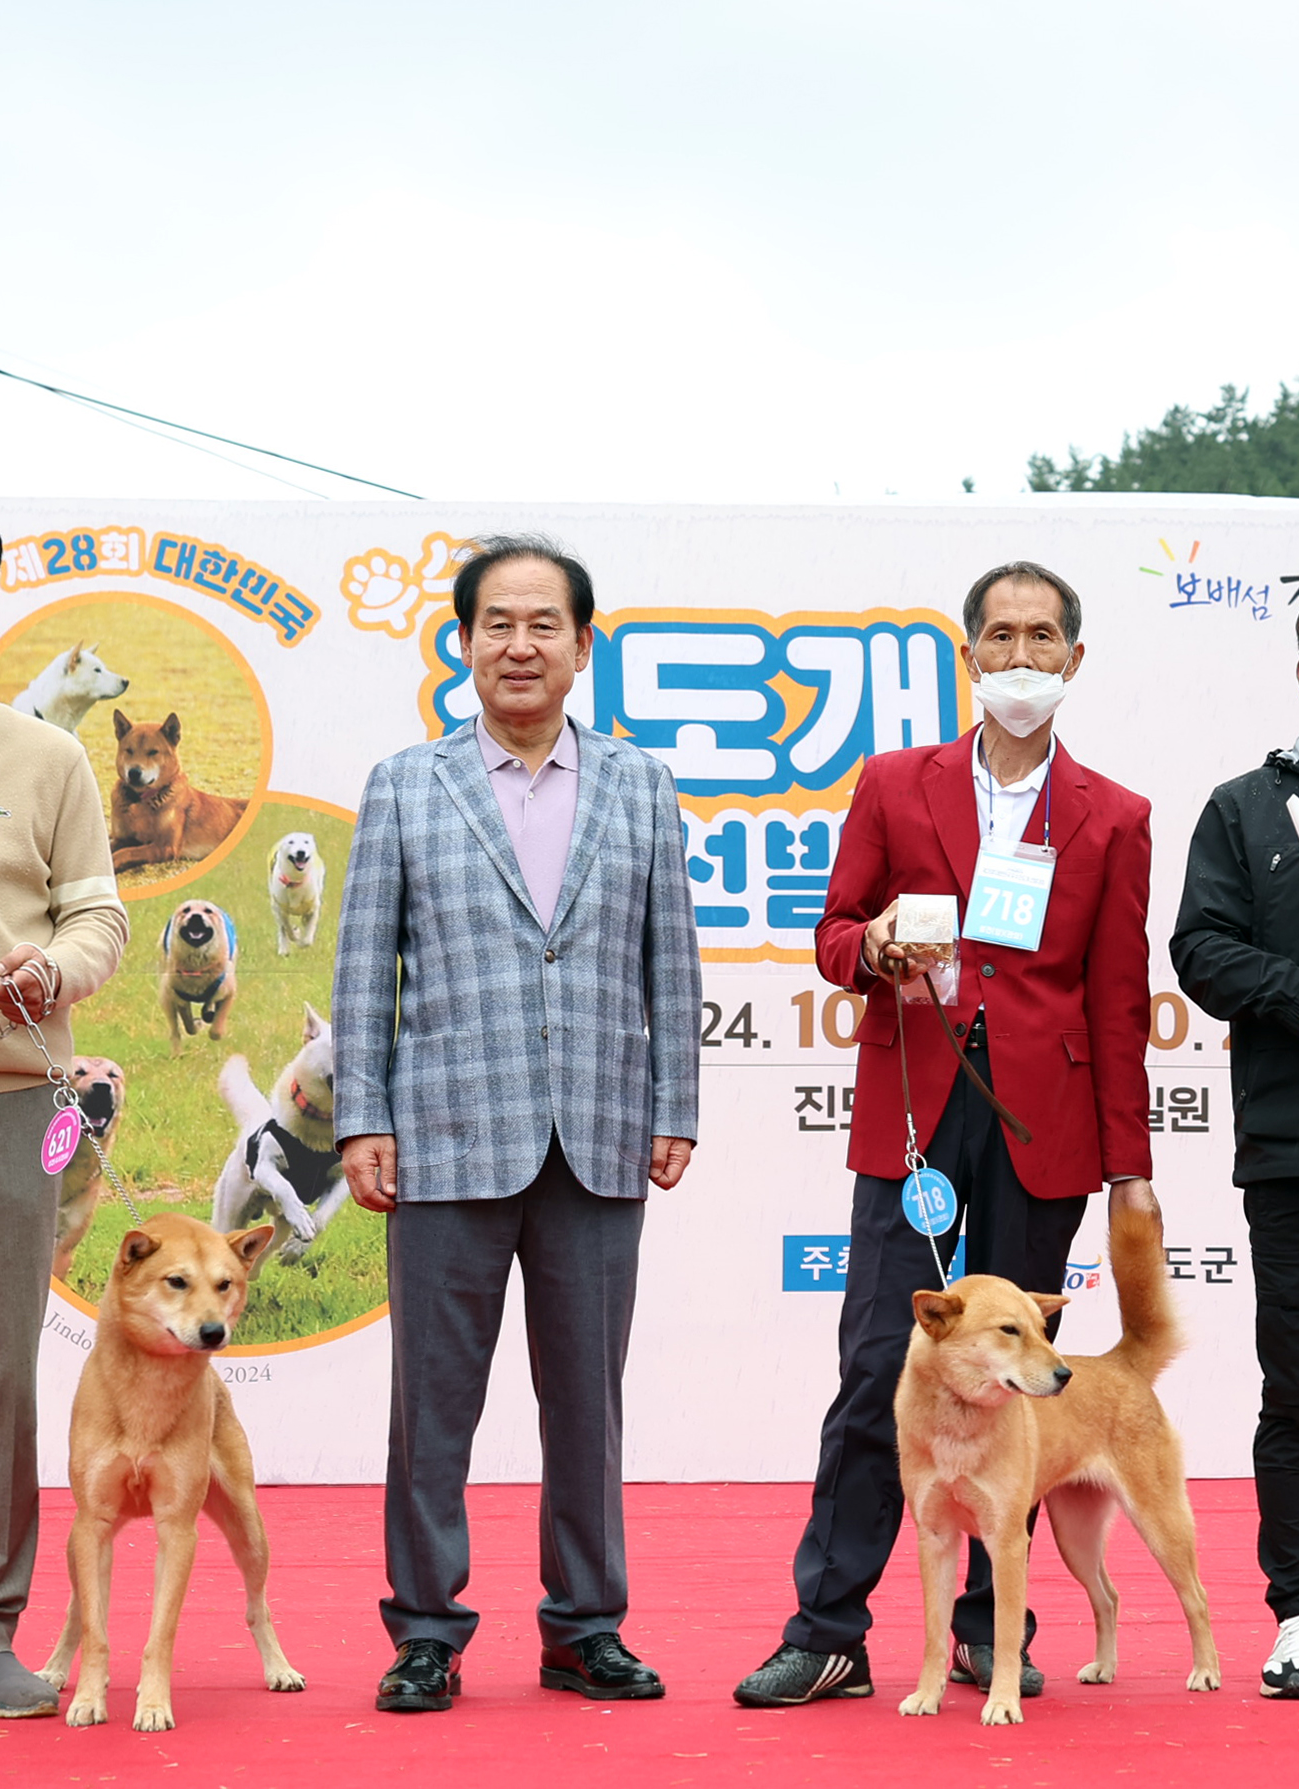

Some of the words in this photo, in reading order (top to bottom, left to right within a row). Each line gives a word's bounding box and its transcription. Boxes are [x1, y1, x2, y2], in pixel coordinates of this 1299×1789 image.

[4, 531, 140, 588] 제28회
[153, 538, 314, 641] 대한민국
[1169, 572, 1273, 621] 보배섬
[980, 886, 1035, 926] 718
[48, 1125, 72, 1158] 621
[42, 1311, 93, 1351] Jindo
[224, 1363, 273, 1384] 2024
